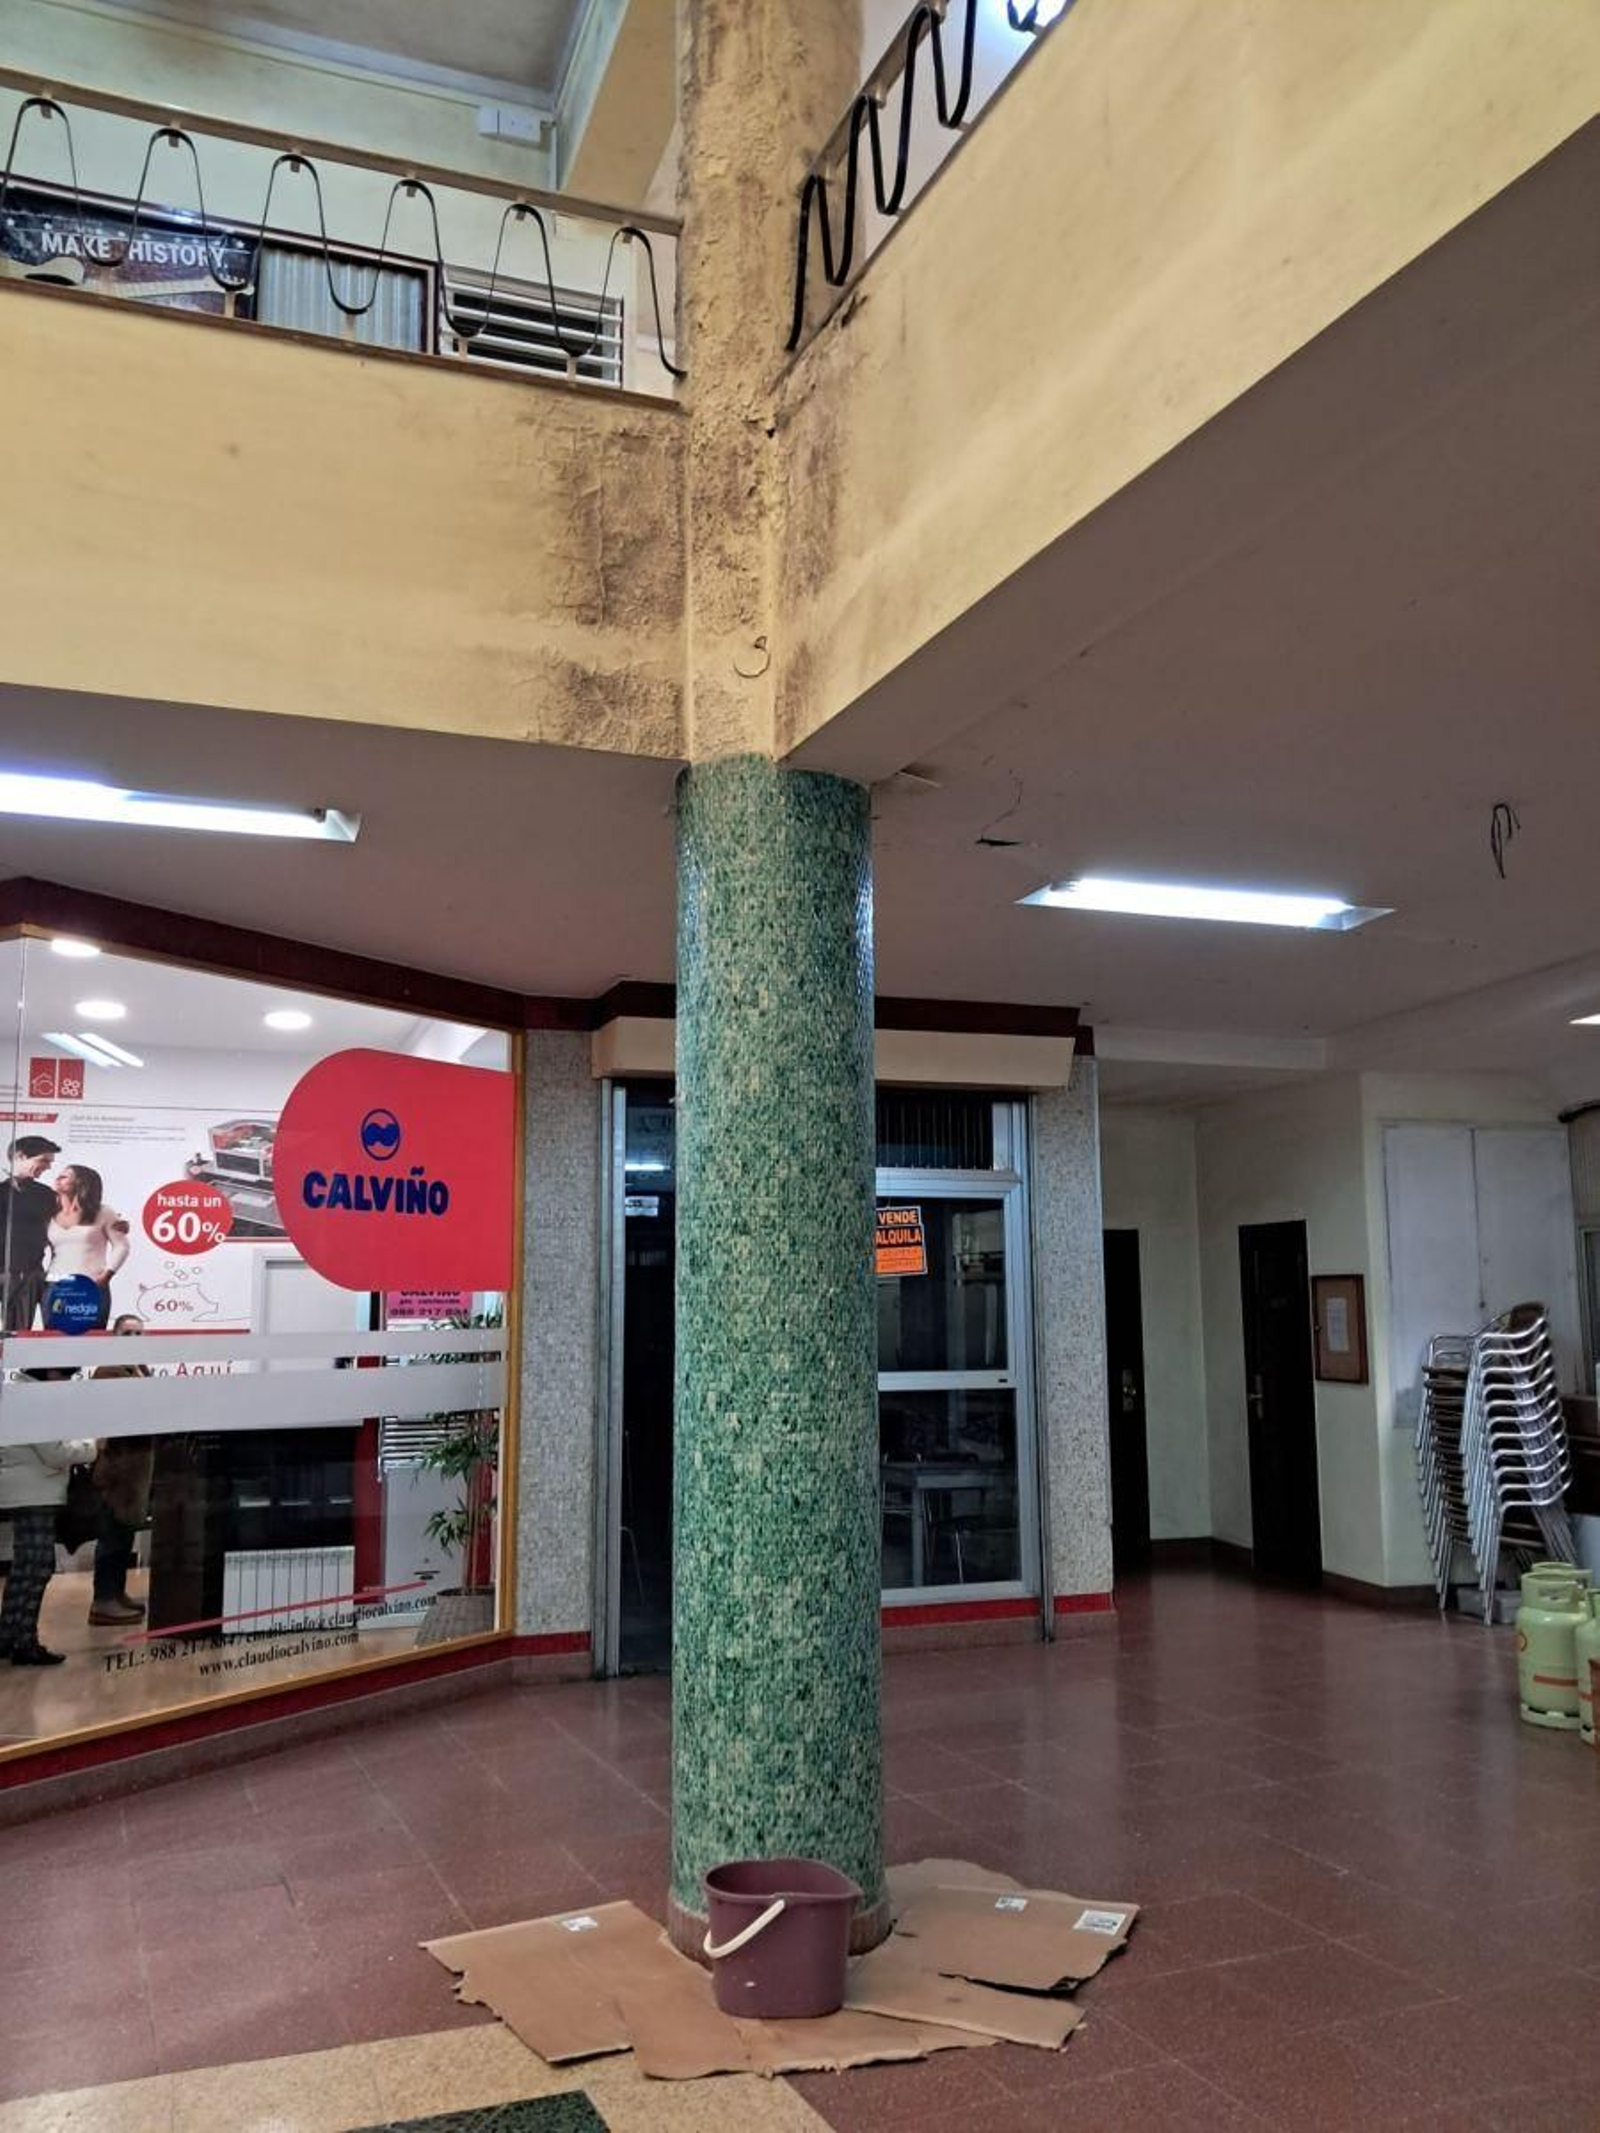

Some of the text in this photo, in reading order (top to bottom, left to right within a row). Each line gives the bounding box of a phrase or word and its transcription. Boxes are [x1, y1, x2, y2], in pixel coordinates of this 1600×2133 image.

[41, 231, 111, 259] MAKE
[157, 1193, 222, 1207] hasta un
[303, 1166, 449, 1216] CALVIÑO
[152, 1210, 226, 1243] 60%
[878, 1210, 918, 1225] VENDE
[154, 1298, 194, 1312] 60%
[103, 1648, 145, 1673] TEL:
[150, 1641, 177, 1663] 988
[200, 1630, 359, 1676] www.claudiocalvino.com
